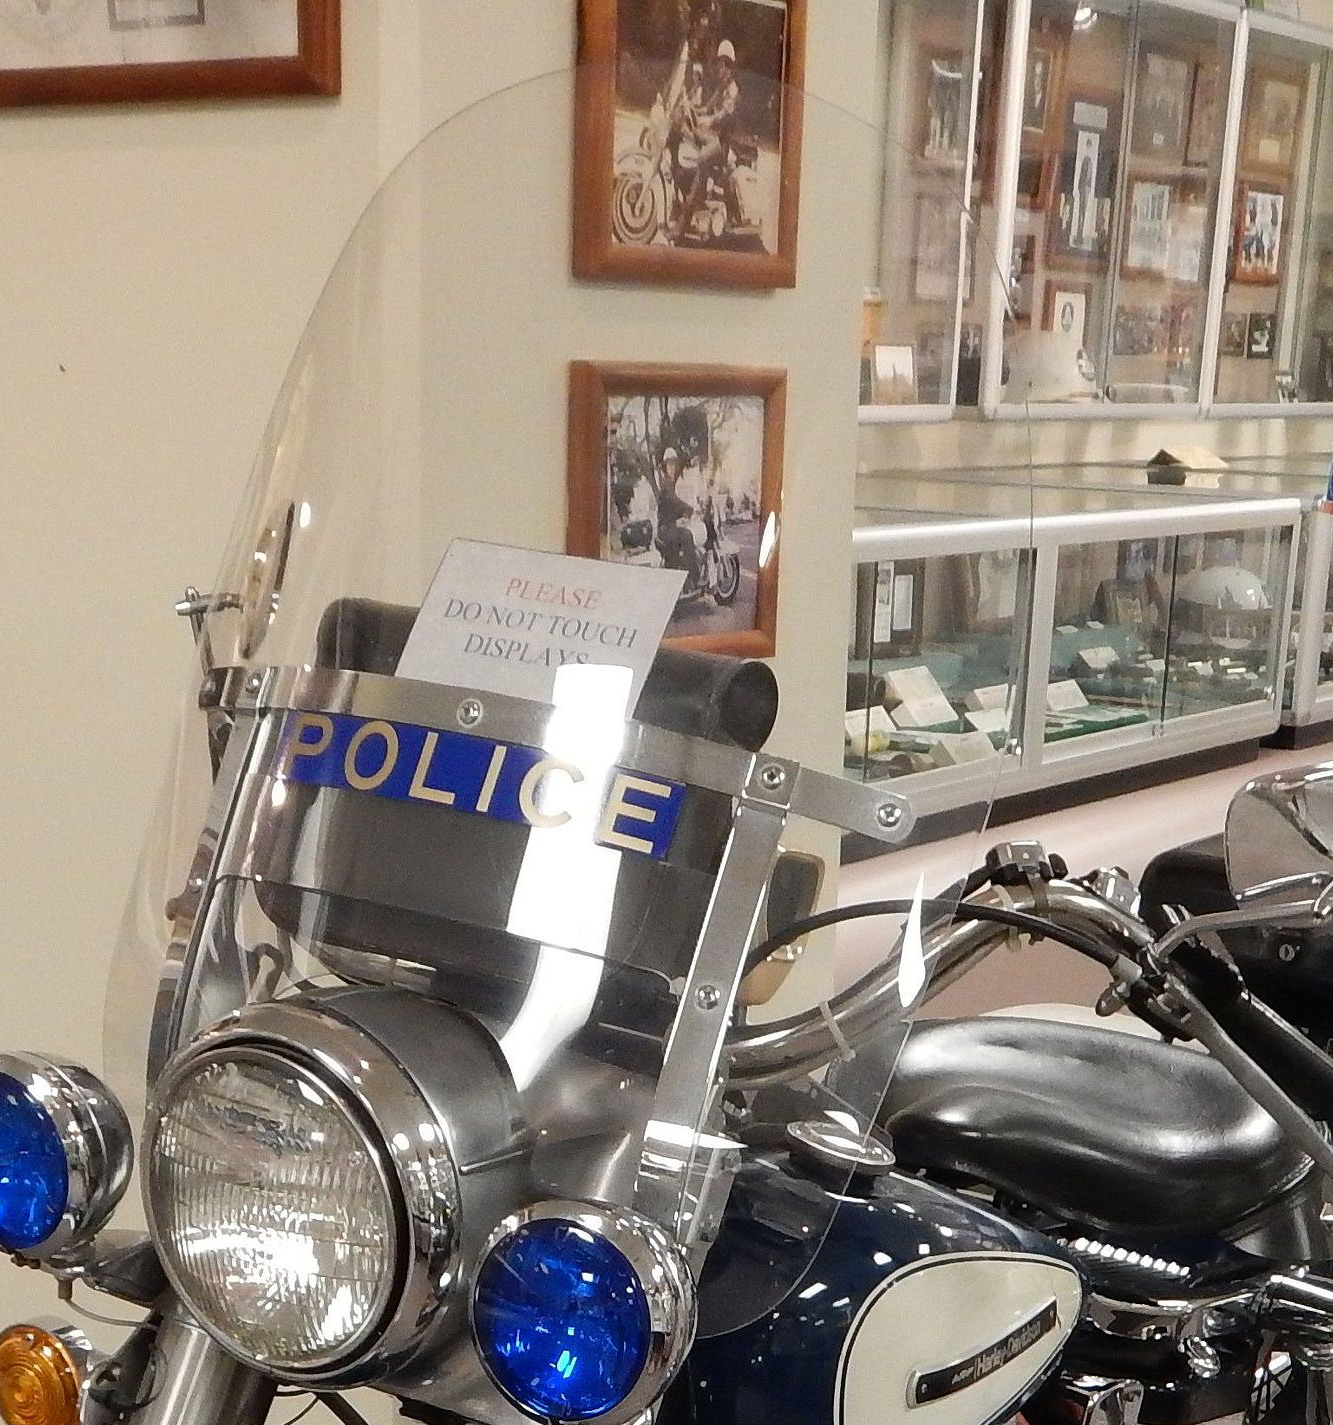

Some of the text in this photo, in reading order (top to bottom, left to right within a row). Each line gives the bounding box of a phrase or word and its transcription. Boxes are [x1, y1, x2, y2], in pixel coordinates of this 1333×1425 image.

[505, 577, 602, 610] PLEASE
[444, 598, 638, 649] DO NOT TOUCH
[281, 713, 672, 855] POLICE
